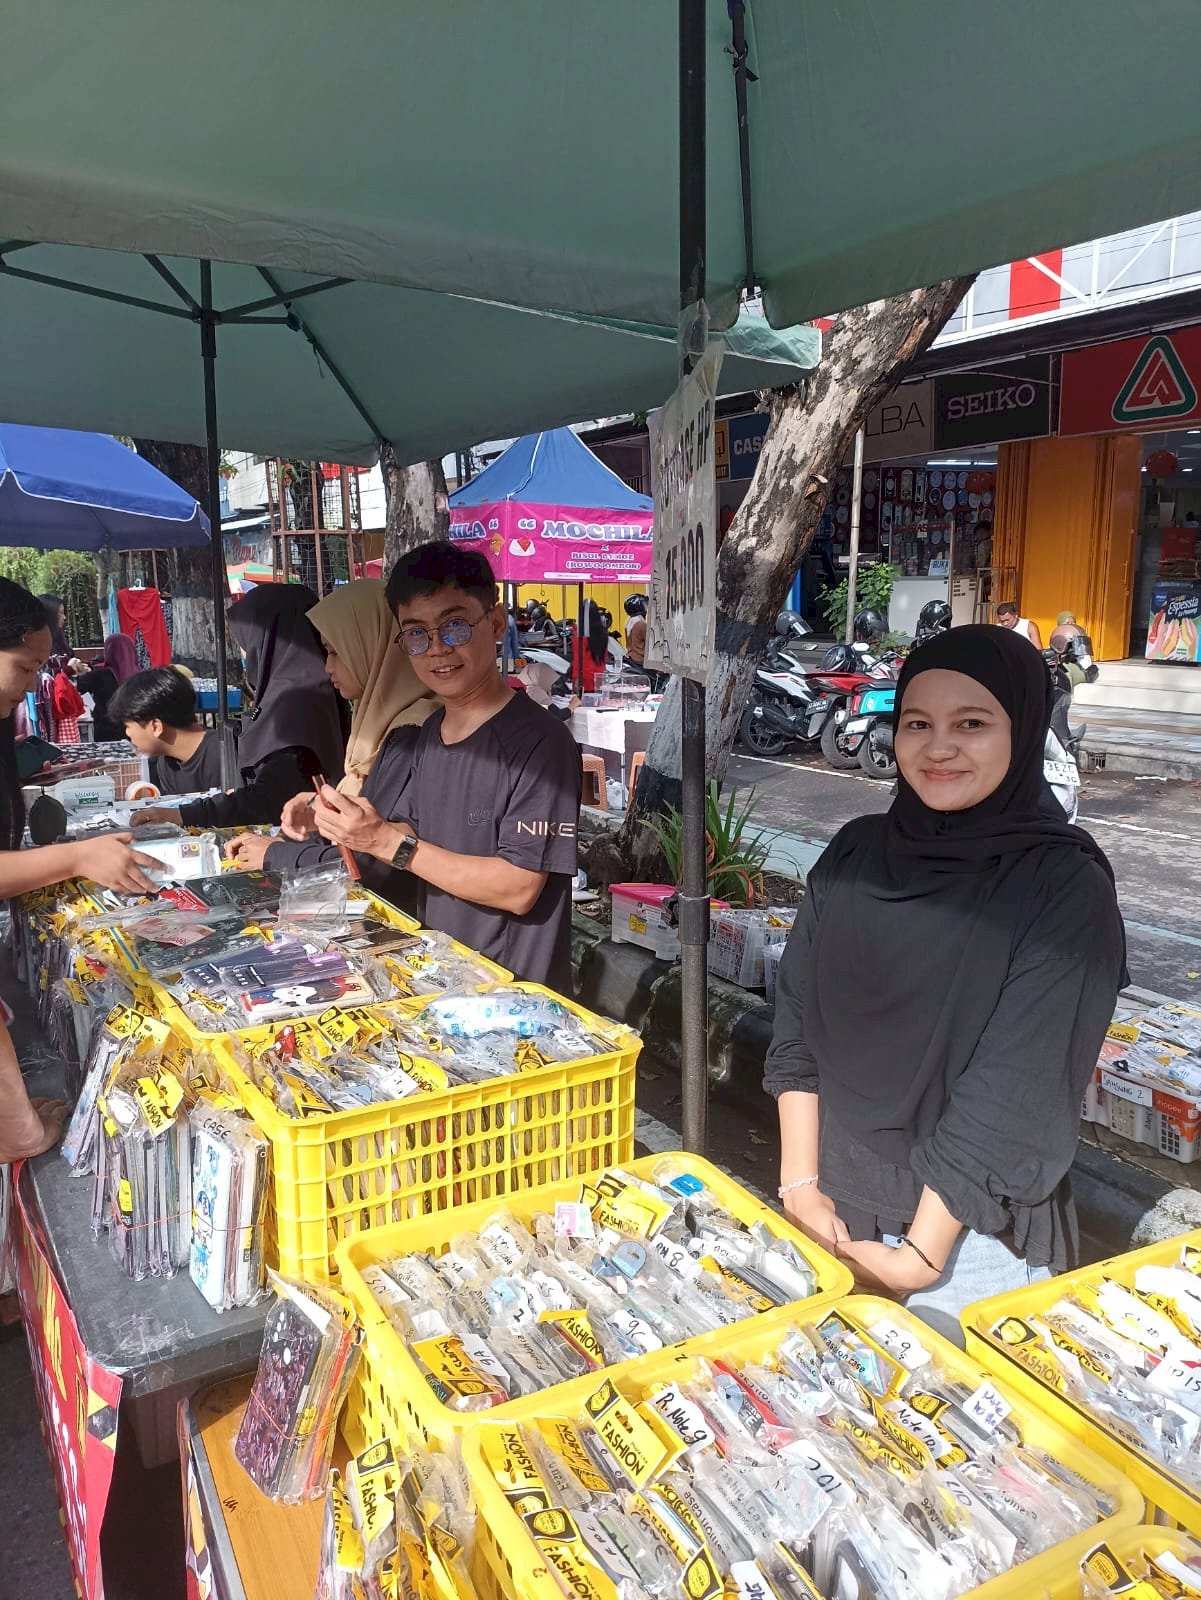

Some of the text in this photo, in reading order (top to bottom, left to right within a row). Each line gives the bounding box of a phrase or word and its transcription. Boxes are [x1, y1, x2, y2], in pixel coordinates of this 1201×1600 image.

[864, 401, 925, 438] LBA
[947, 384, 1036, 420] SEIKO
[660, 399, 711, 512] SOCASE HP
[733, 435, 762, 456] CAS
[666, 521, 705, 621] 15.000
[517, 820, 576, 837] NIKE
[326, 1025, 344, 1043] FASHION
[145, 1099, 163, 1130] FASHION
[202, 1117, 232, 1139] CASE
[600, 1211, 639, 1234] FASHION
[566, 1317, 601, 1357] FASHION
[848, 1360, 866, 1374] case
[1018, 1349, 1060, 1386] FASHION
[669, 1407, 692, 1436] Note
[898, 1408, 924, 1435] Note
[505, 1432, 539, 1479] FASHION
[602, 1421, 645, 1477] FASHION
[360, 1478, 377, 1525] FASHI
[543, 1546, 594, 1600] FASHION
